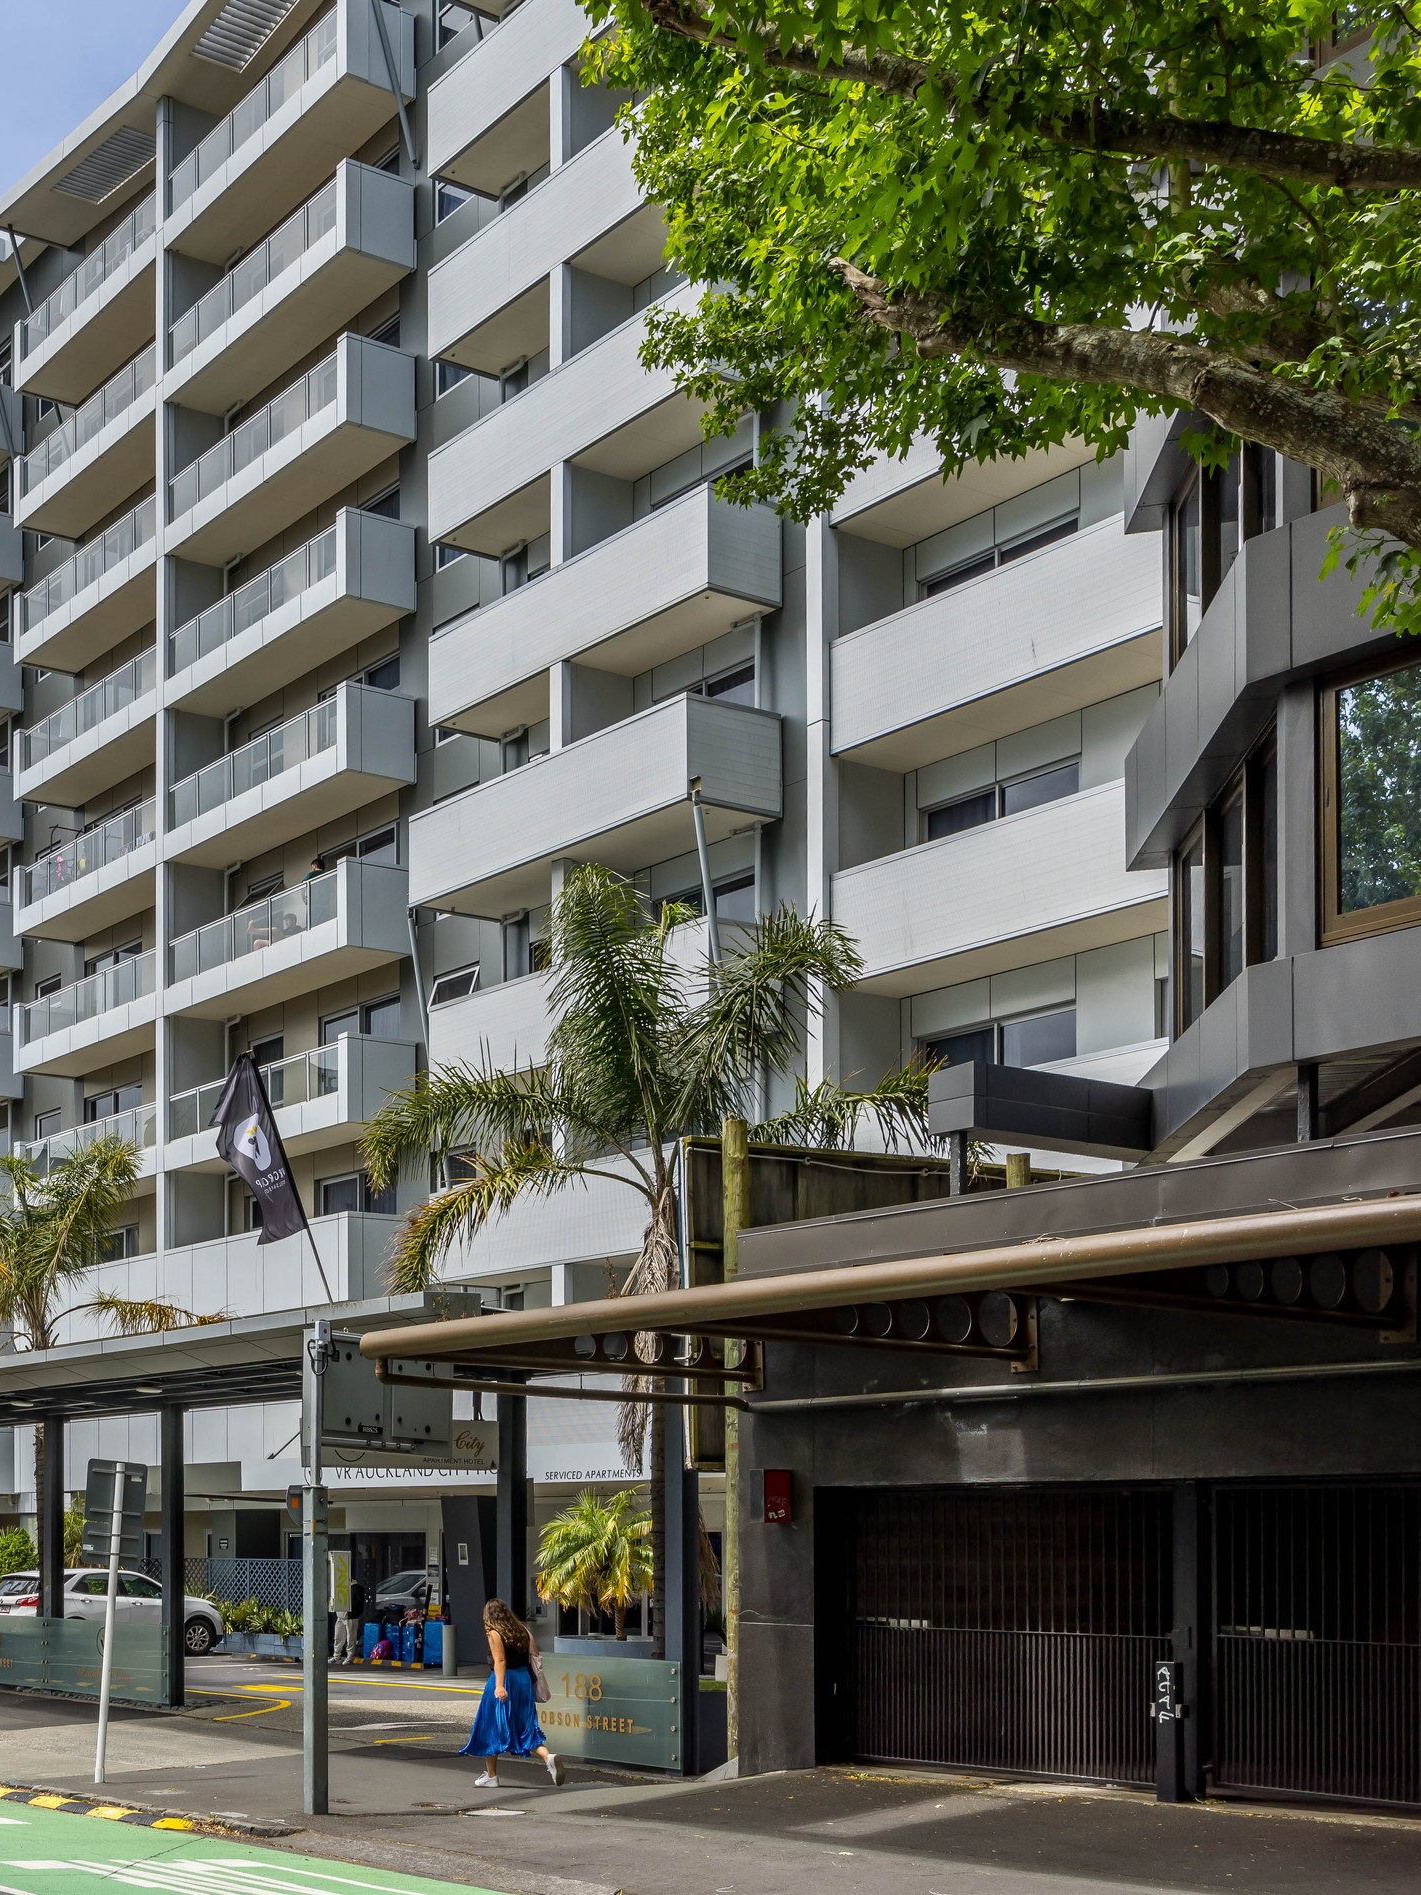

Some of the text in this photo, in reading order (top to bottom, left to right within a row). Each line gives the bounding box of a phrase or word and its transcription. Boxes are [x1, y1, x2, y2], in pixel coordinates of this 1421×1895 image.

[453, 1430, 486, 1457] City
[545, 1468, 641, 1480] SERVICED APARTMENTS
[561, 1672, 603, 1701] 188
[539, 1710, 634, 1734] OBSON STREET
